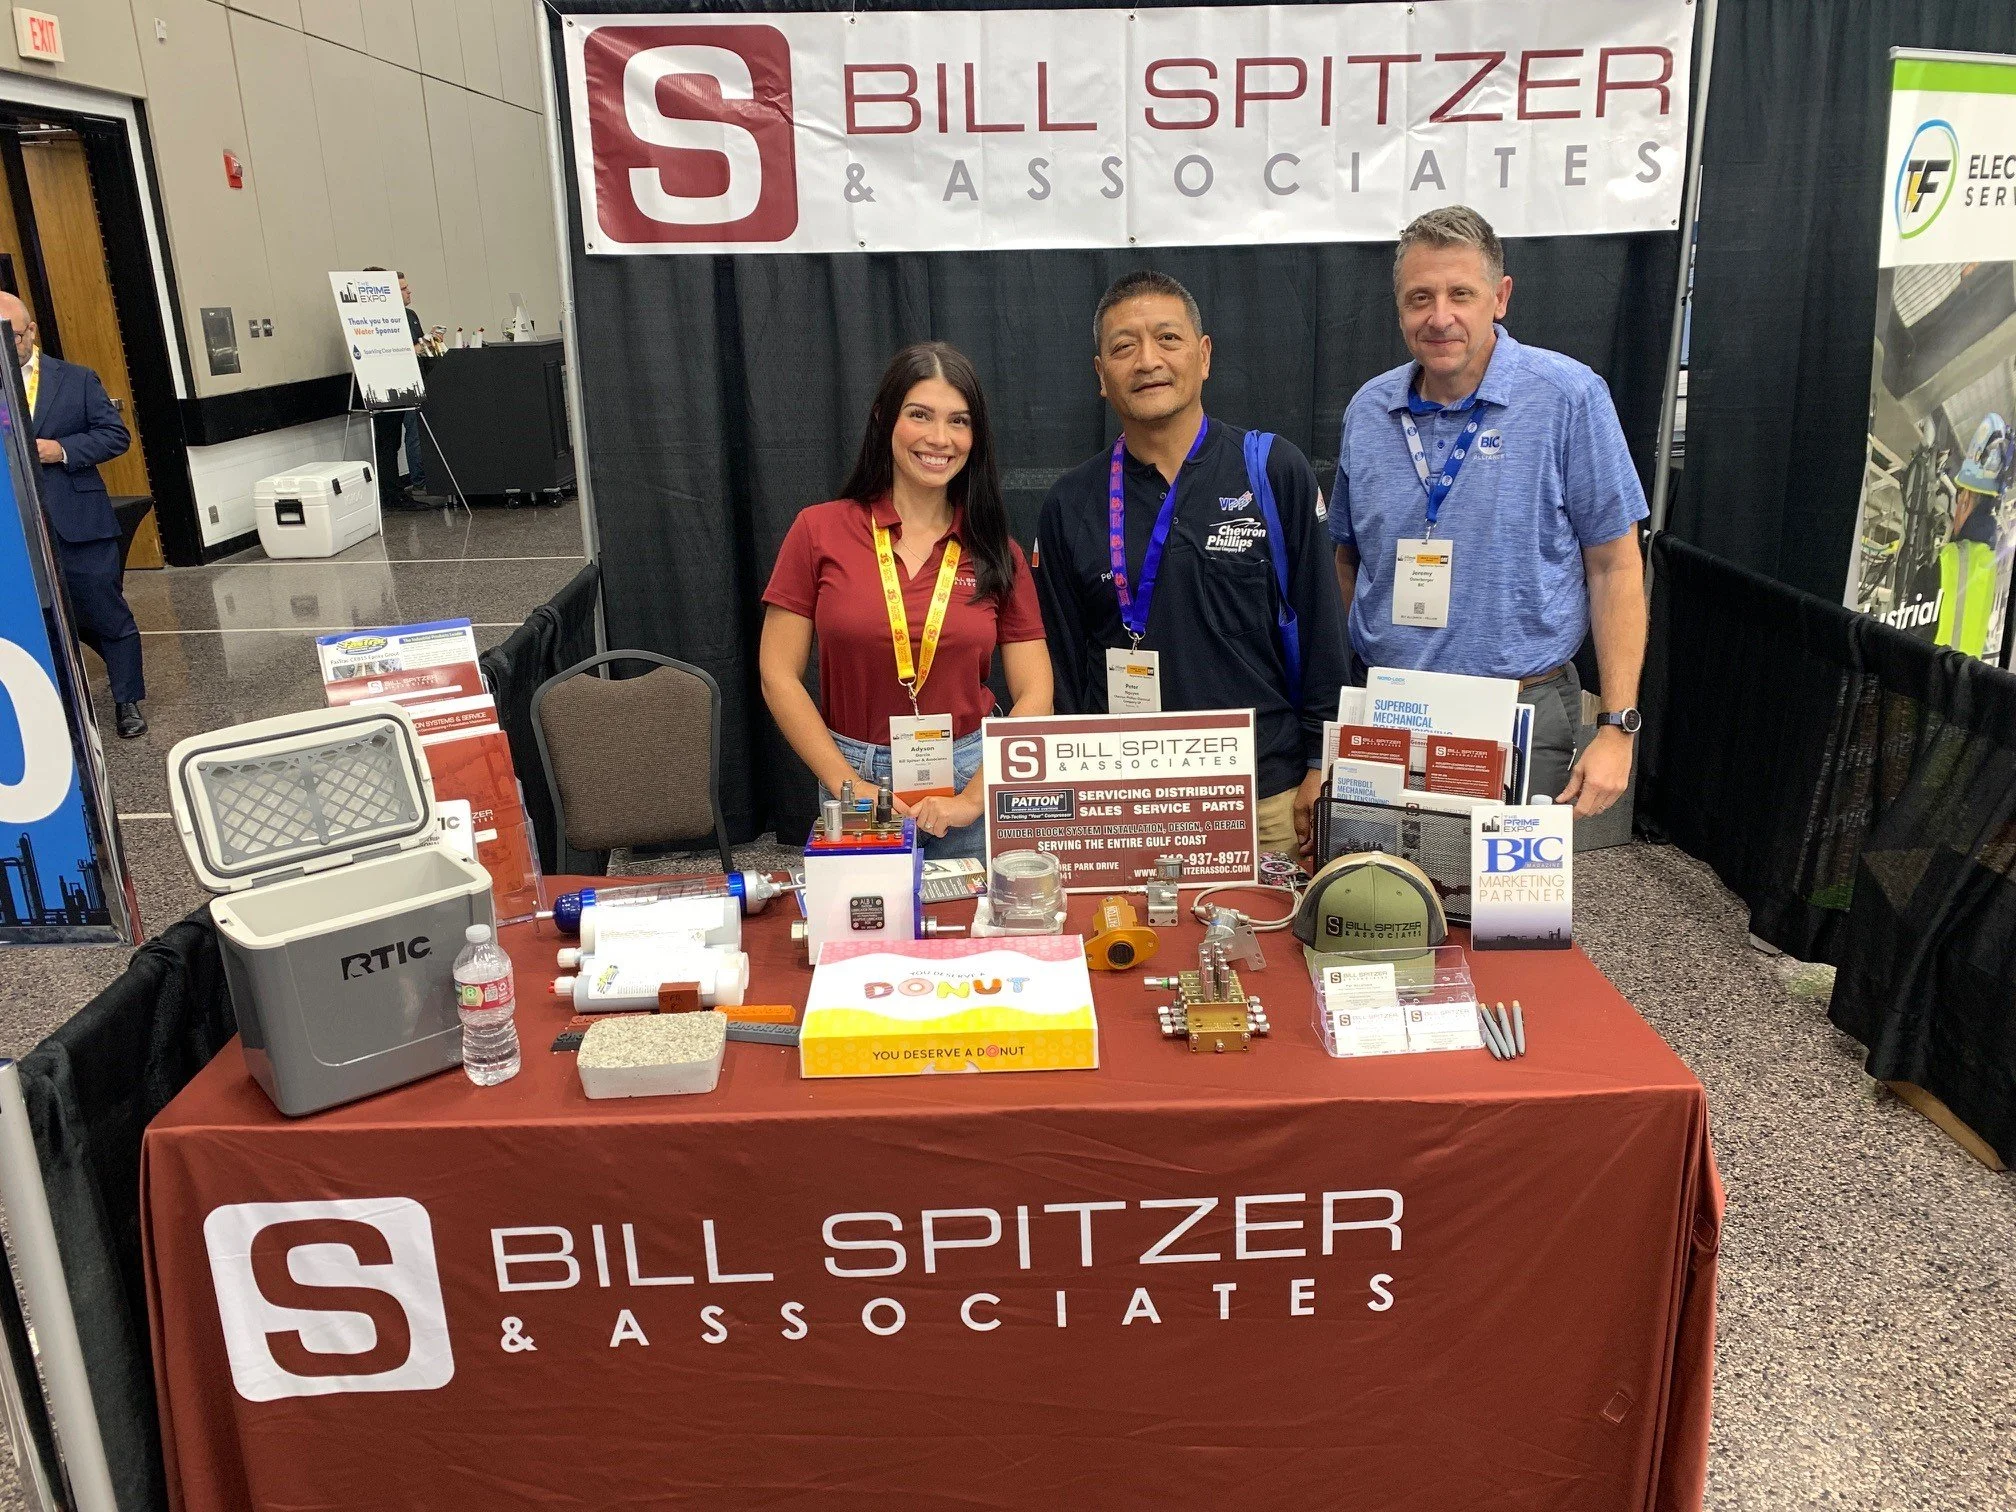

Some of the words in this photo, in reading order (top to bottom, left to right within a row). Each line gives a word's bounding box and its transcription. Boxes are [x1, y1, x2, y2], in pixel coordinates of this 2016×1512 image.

[29, 17, 57, 54] EXIT
[844, 61, 1098, 136] BILL
[1144, 46, 1675, 131] SPITZER
[844, 162, 877, 203] &
[943, 141, 1664, 203] ASSOCIATES
[1966, 186, 2016, 207] SER
[358, 286, 391, 295] PRIME
[360, 294, 387, 303] EXPO
[348, 317, 368, 325] Thank
[369, 319, 381, 327] you
[354, 328, 374, 336] Water
[375, 327, 400, 336] Sponsor
[1480, 435, 1500, 448] BIC
[1218, 525, 1267, 538] Chevron
[1207, 535, 1254, 552] Phillips
[403, 674, 438, 683] SPITZER
[1374, 699, 1429, 715] SUPERBOLT
[426, 716, 455, 727] SYSTEMS
[462, 712, 486, 721] SERVICE
[1373, 711, 1433, 728] MECHANICAL
[1056, 742, 1113, 759] BILL
[1122, 737, 1238, 757] SPITZER
[1059, 762, 1067, 772] &
[1080, 756, 1237, 772] ASSOCIATES
[1336, 785, 1377, 797] MECHANICAL
[1337, 777, 1373, 789] SUPERBOLT
[1079, 788, 1152, 801] SERVICING
[1155, 785, 1245, 798] DISTRIBUTOR
[1011, 796, 1060, 807] PATTON
[1080, 805, 1122, 817] SALES
[1133, 803, 1191, 815] SERVICE
[1202, 800, 1245, 812] PARTS
[997, 828, 1033, 839] DIVIDER
[1035, 827, 1065, 837] BLOCK
[1066, 825, 1101, 836] SYSTEM
[1103, 823, 1166, 836] INSTALLATION,
[1168, 821, 1203, 833] DESIGN,
[1205, 821, 1211, 831] &
[1214, 820, 1246, 830] REPAIR
[1037, 840, 1082, 852] SERVING
[1085, 838, 1104, 849] THE
[1107, 837, 1143, 849] ENTIRE
[1146, 836, 1172, 847] GULF
[1174, 835, 1208, 846] COAST
[1482, 836, 1563, 873] BIC
[1073, 862, 1095, 871] PARK
[1096, 861, 1119, 870] DRIVE
[1479, 874, 1565, 888] MARKETING
[1480, 888, 1565, 902] PARTNER
[1345, 921, 1371, 931] BILL
[1374, 921, 1422, 932] SPITZER
[341, 936, 432, 981] RTIC
[864, 977, 1031, 1000] DONUT
[873, 1051, 900, 1060] YOU
[904, 1048, 961, 1059] DESERVE
[965, 1048, 972, 1057] A
[977, 1045, 1025, 1057] DONUT
[491, 1219, 774, 1293] BILL
[821, 1188, 1404, 1278] SPITZER
[500, 1316, 538, 1354] &
[609, 1272, 1396, 1348] ASSOCIATES
